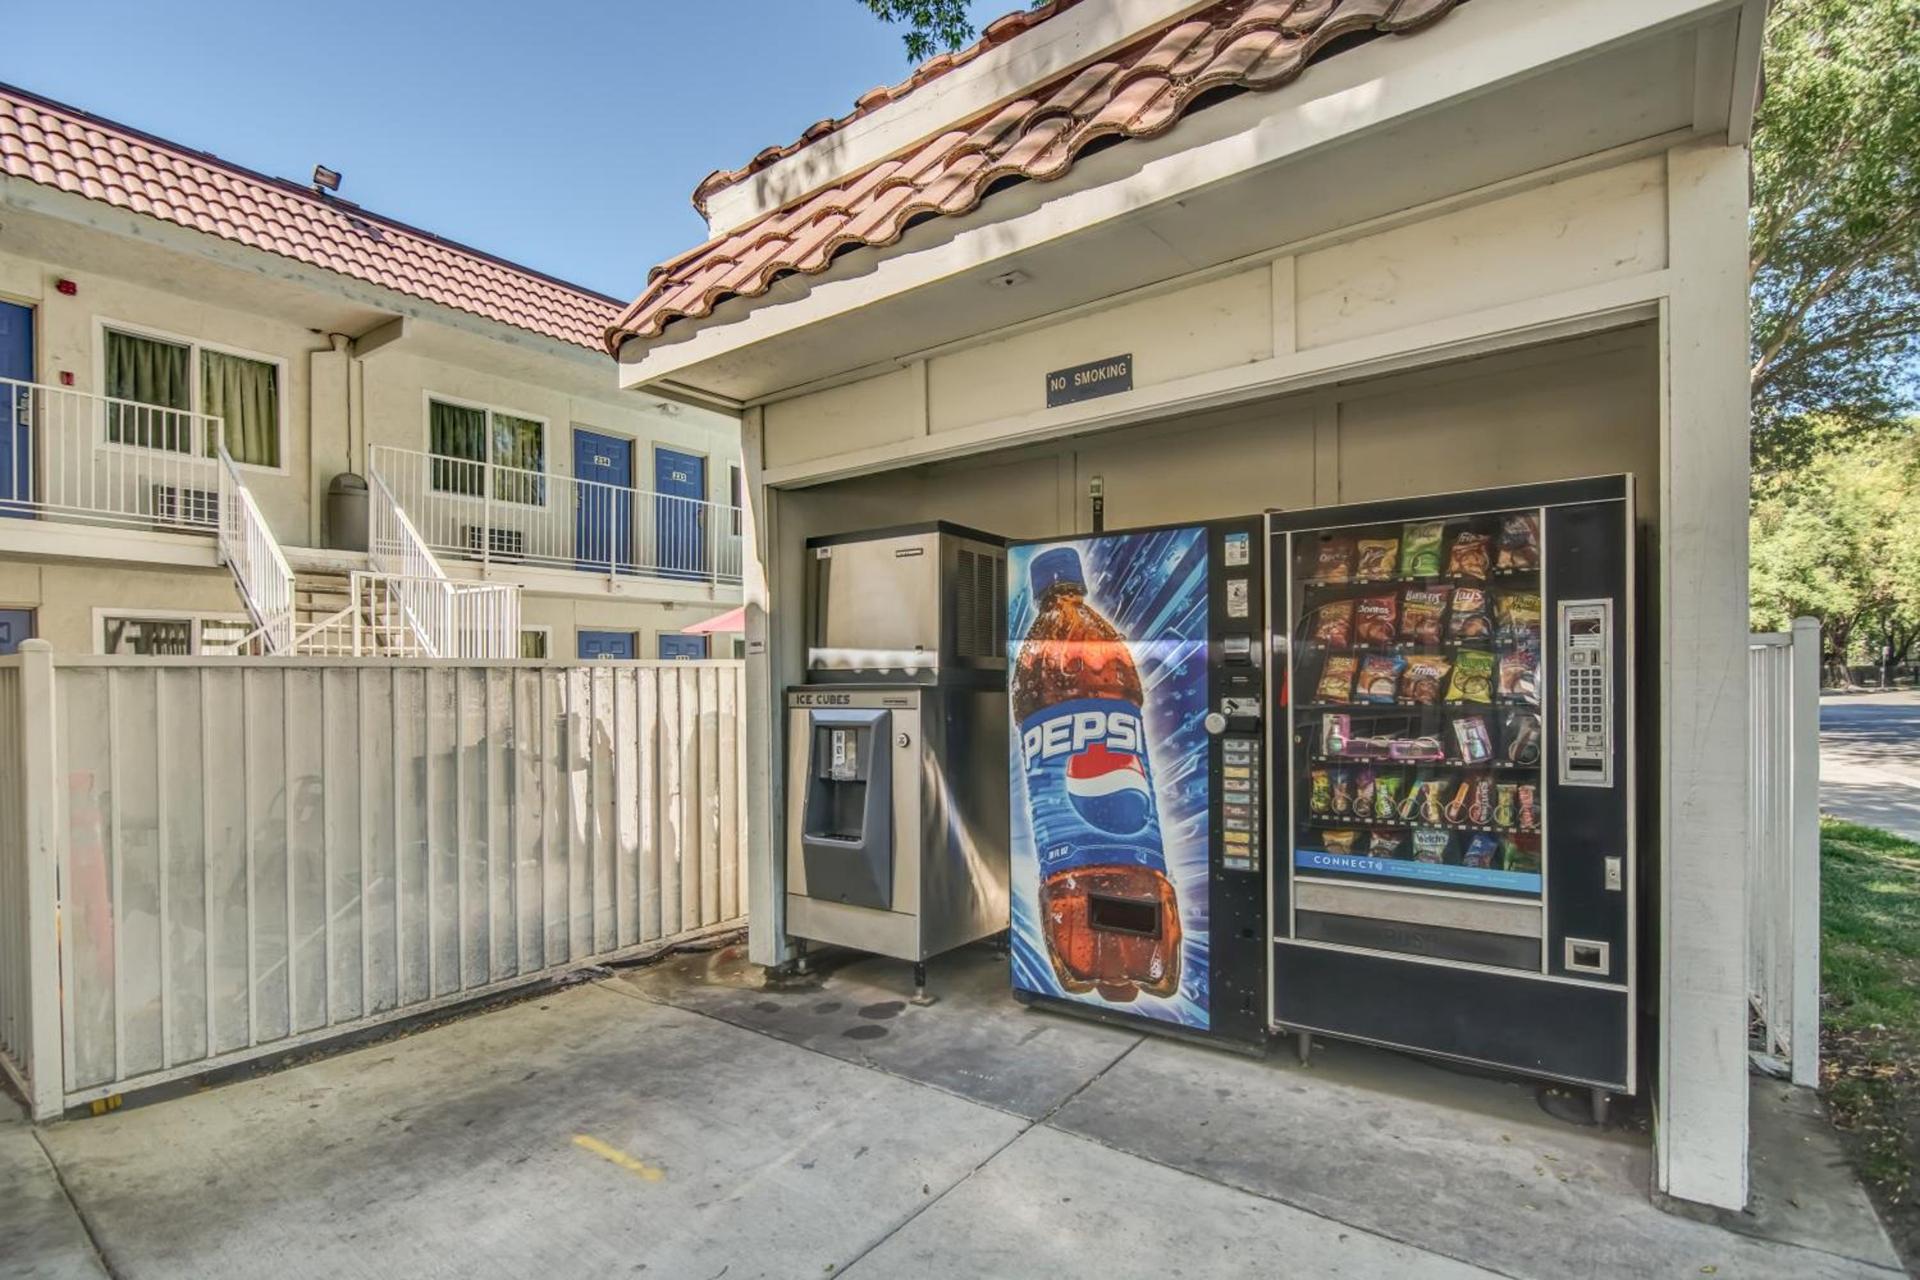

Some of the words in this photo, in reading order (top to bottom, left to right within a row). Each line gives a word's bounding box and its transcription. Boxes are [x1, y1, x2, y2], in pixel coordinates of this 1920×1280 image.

[1051, 377, 1066, 391] NO
[1074, 363, 1127, 386] SMOKING
[796, 694, 813, 704] ICE
[816, 694, 851, 705] CUBES
[1023, 711, 1144, 771] PEPSI
